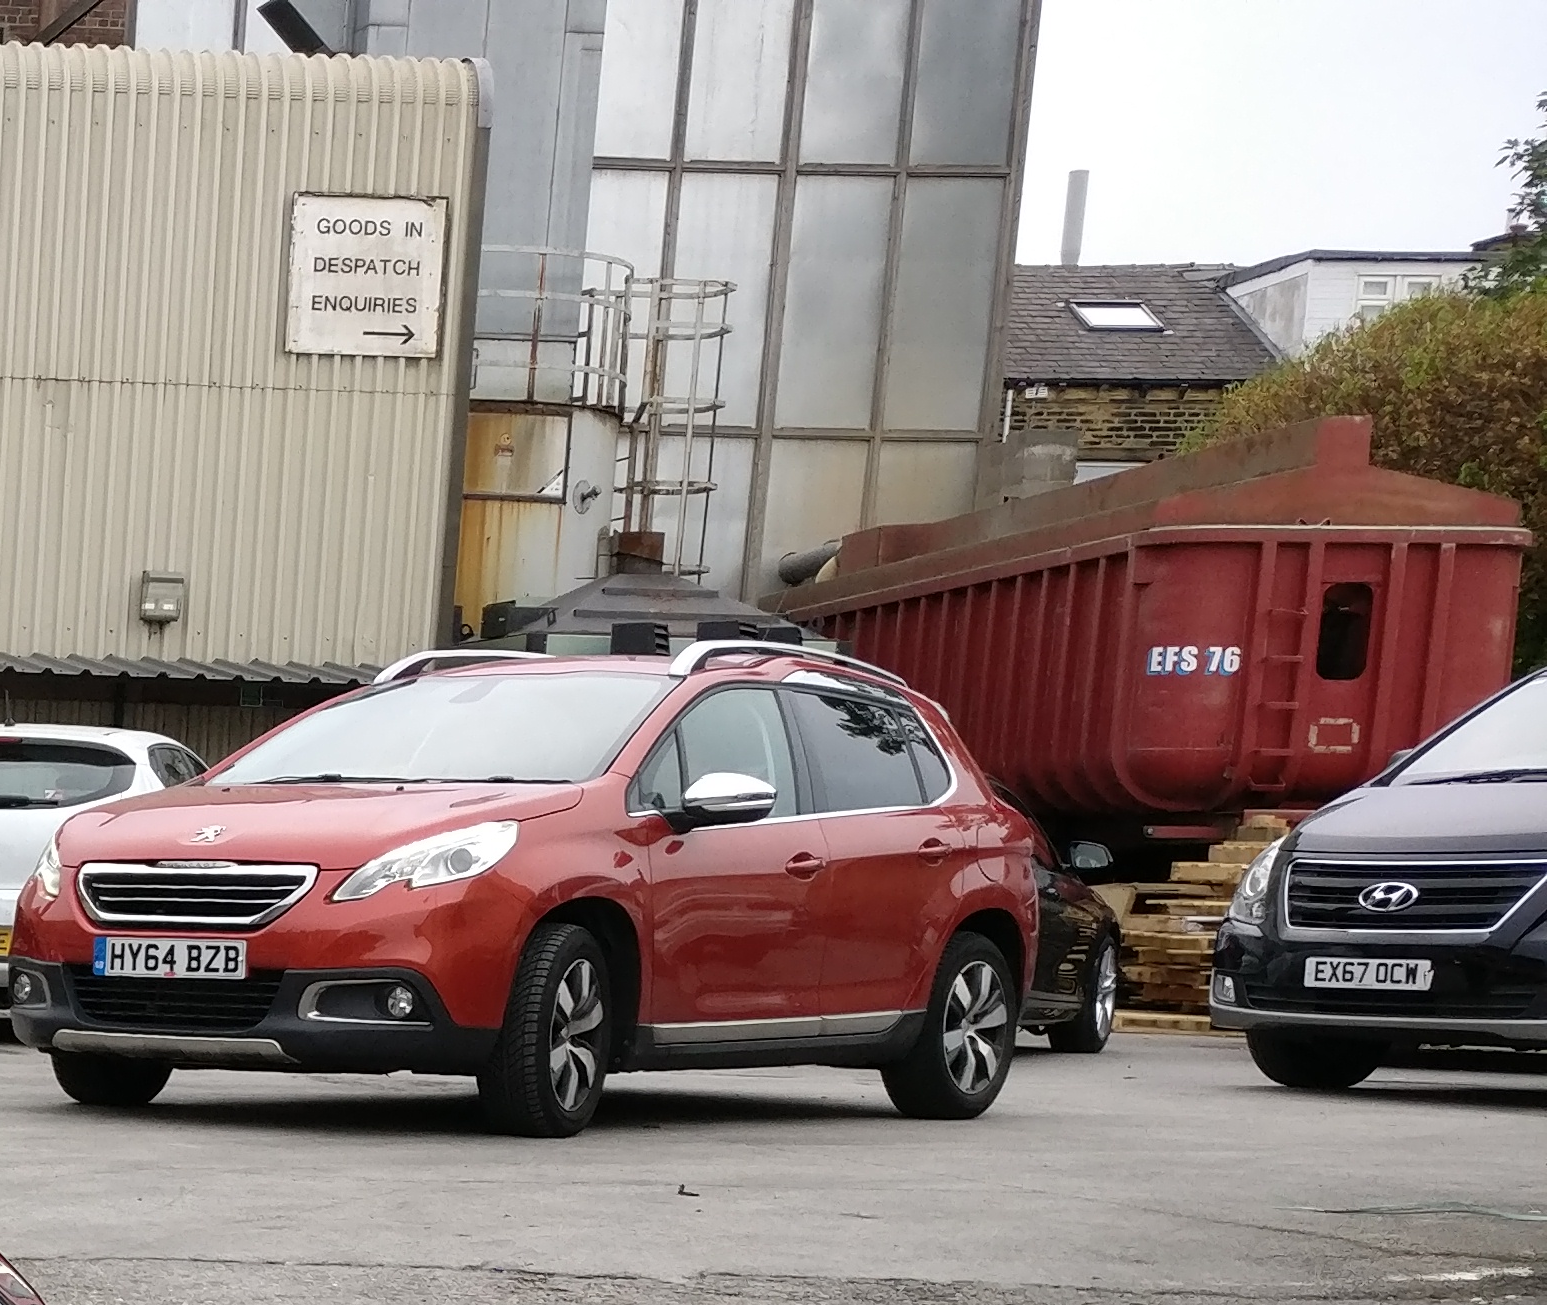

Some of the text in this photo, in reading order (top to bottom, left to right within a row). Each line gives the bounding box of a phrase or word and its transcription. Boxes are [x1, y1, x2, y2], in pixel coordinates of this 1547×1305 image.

[317, 217, 423, 238] GOODS IN
[313, 257, 420, 276] DESPATCH
[311, 295, 417, 313] ENQUIRIES
[1148, 645, 1242, 675] EFS 76
[110, 943, 240, 973] HY64 BZB
[1314, 961, 1419, 985] EX67 OCW
